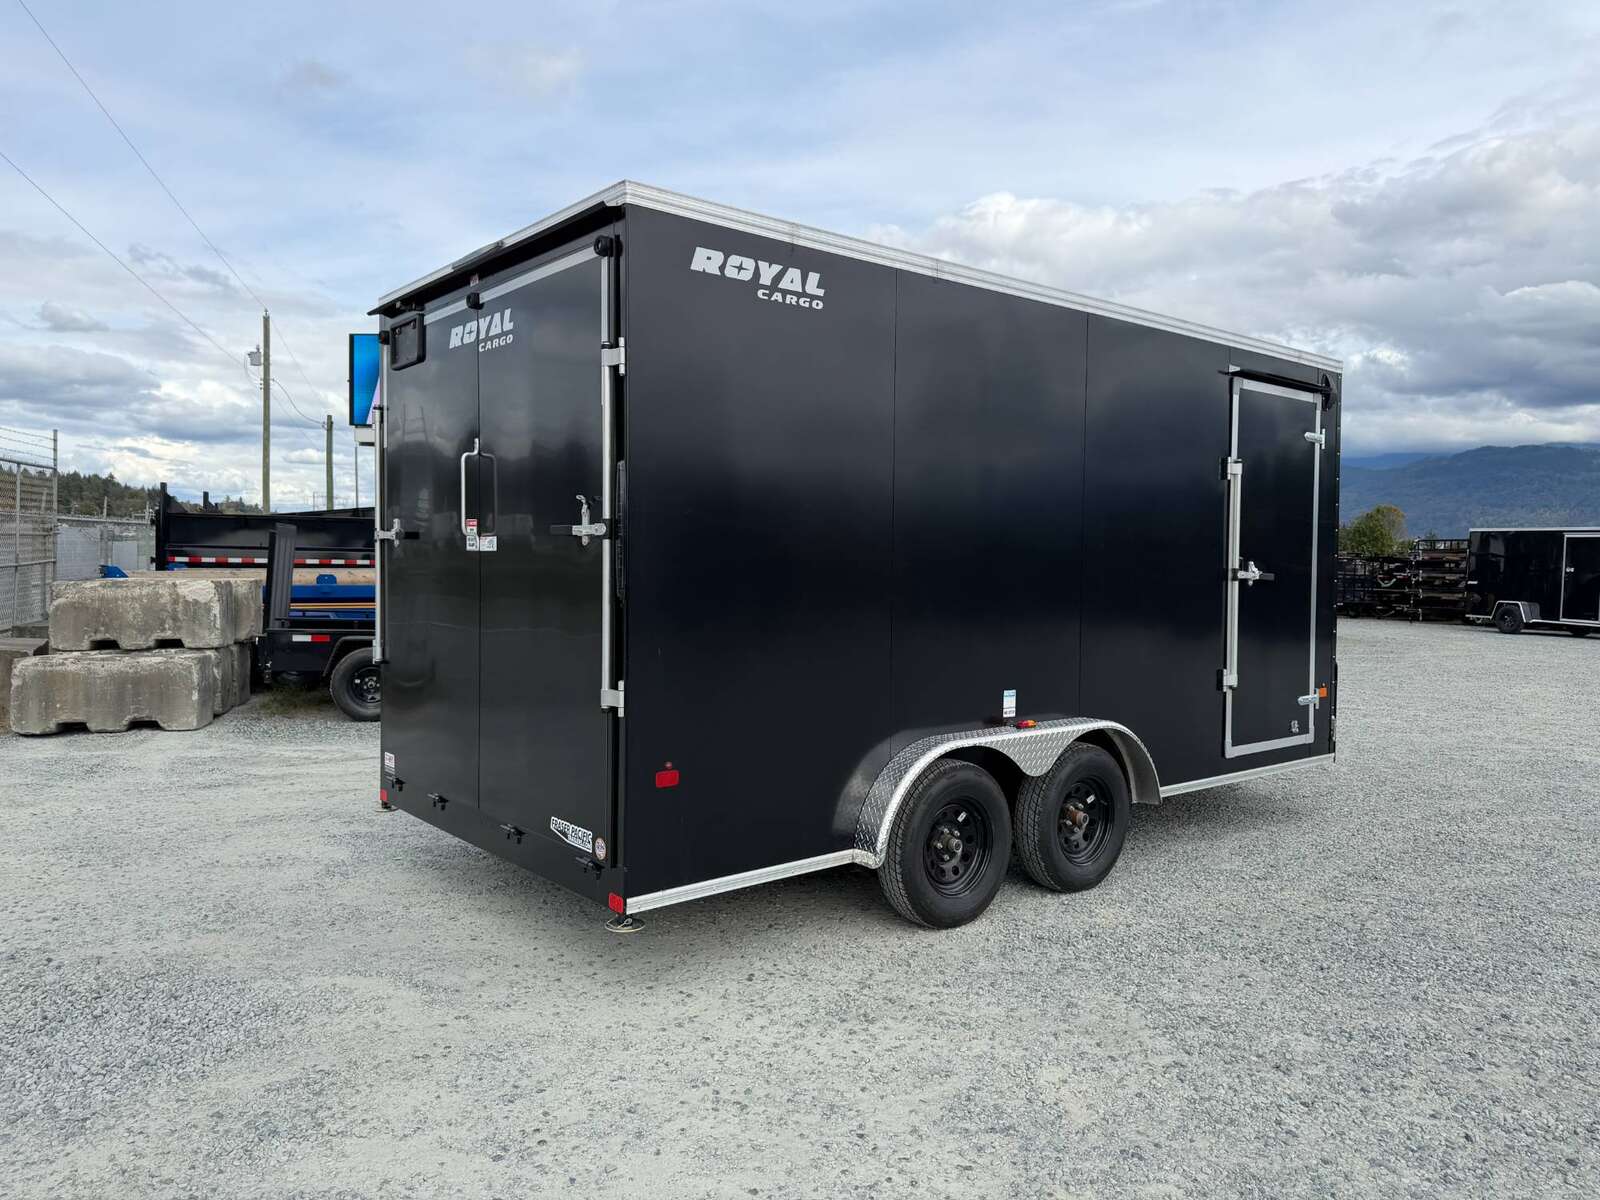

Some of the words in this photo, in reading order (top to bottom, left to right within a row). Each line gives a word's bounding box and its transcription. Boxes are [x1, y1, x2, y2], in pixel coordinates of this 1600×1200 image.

[690, 246, 825, 297] ROYAL
[757, 288, 824, 310] CARGO
[449, 308, 514, 349] ROYAL
[478, 334, 514, 352] CARGO
